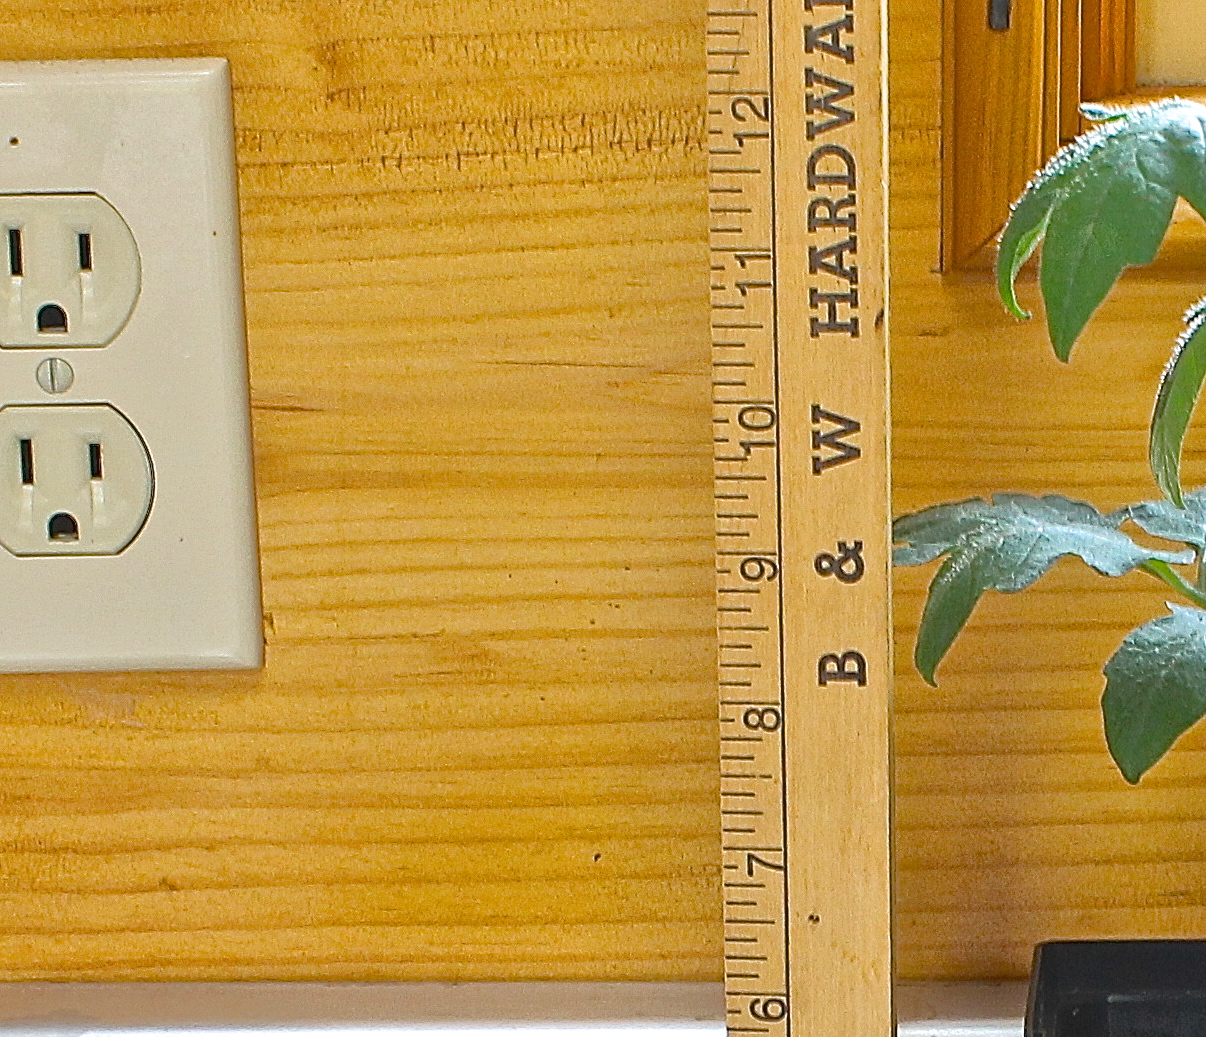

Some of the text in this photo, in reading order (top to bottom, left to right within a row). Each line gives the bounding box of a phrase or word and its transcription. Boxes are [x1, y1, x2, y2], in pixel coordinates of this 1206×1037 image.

[731, 97, 769, 147] 12
[734, 252, 772, 297] 11
[737, 405, 776, 457] 10
[811, 403, 861, 476] W
[740, 557, 778, 582] 9
[813, 540, 865, 584] &
[818, 651, 867, 687] B
[743, 707, 781, 733] 8
[746, 853, 784, 877] 7
[749, 997, 787, 1022] 6
